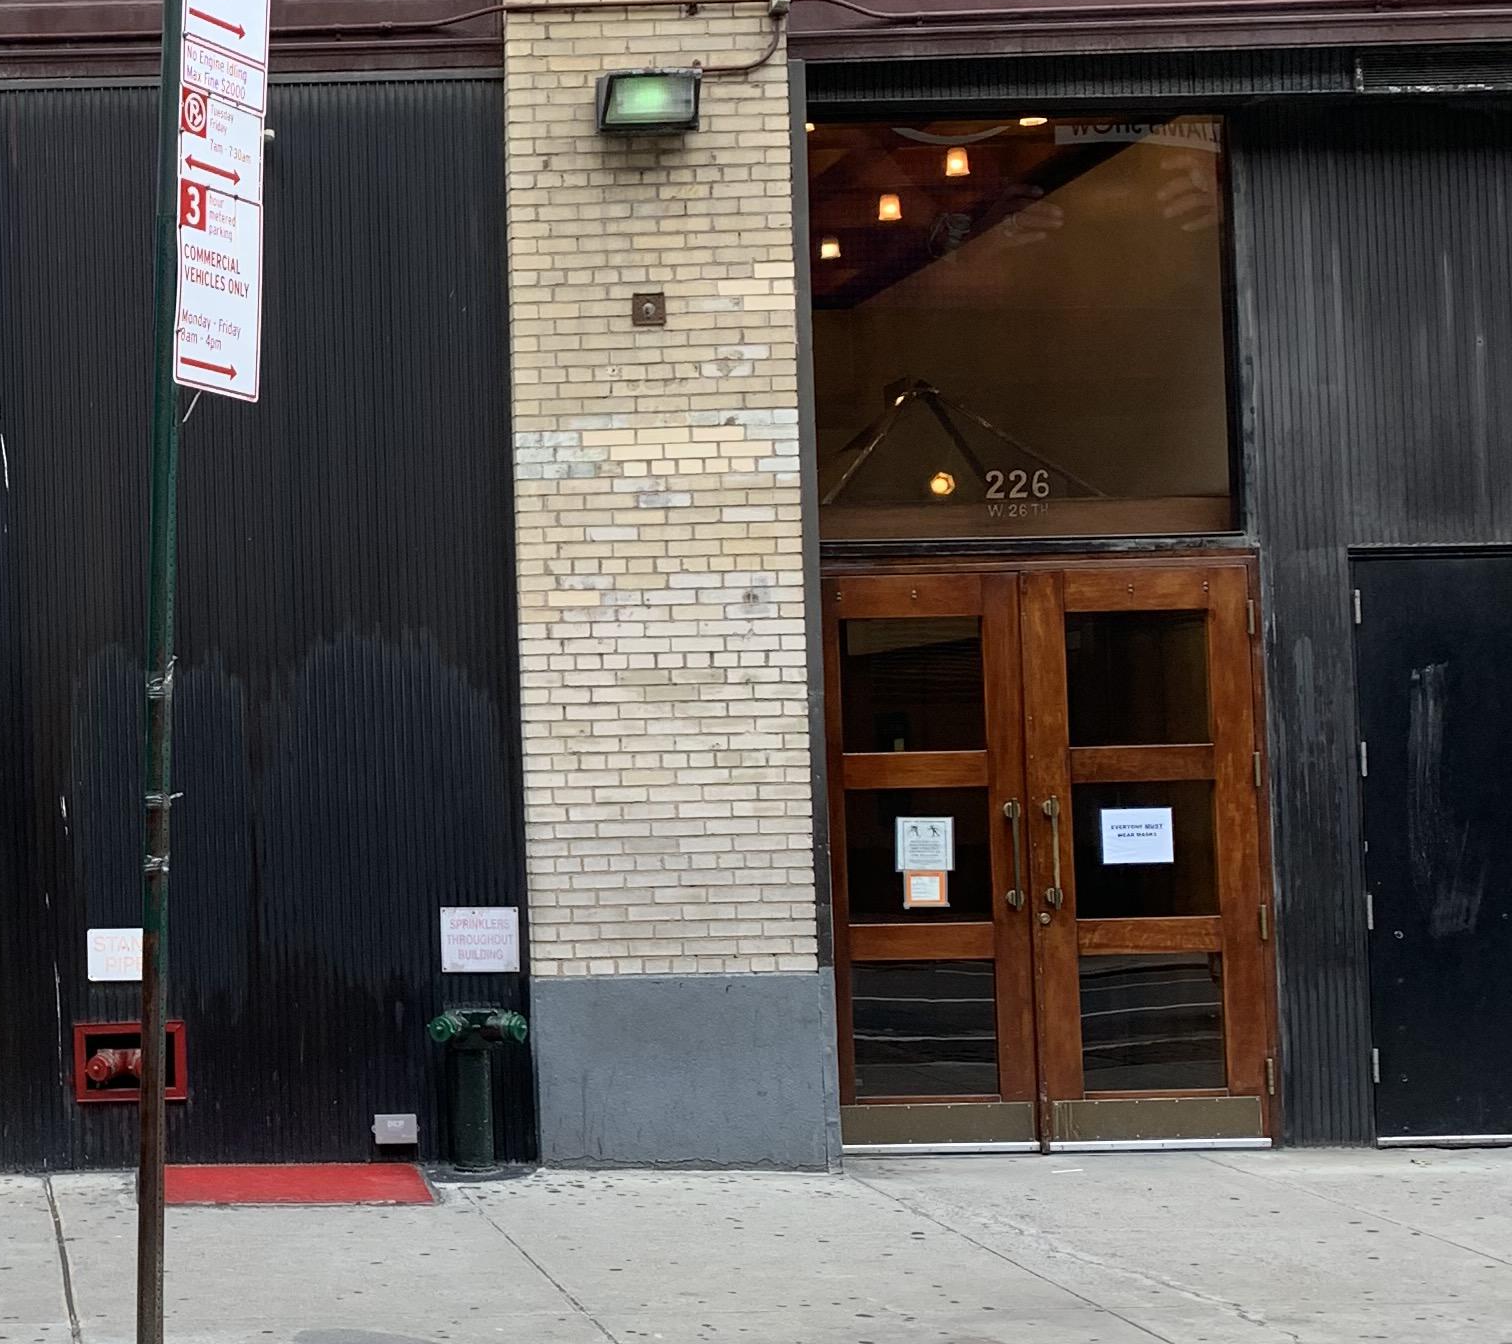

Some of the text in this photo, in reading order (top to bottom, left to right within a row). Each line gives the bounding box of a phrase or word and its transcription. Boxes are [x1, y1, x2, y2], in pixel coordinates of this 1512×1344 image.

[186, 45, 248, 85] No Engine Idling
[186, 64, 246, 100] Max Fine $2000
[210, 103, 234, 124] Tuesday
[209, 118, 227, 135] Friday
[229, 145, 252, 164] 730am
[185, 185, 201, 225] 3
[209, 193, 225, 209] hour
[209, 210, 237, 228] metered
[208, 224, 233, 243] parking
[184, 242, 241, 275] COMMERCIAL
[184, 264, 250, 299] VEHICLES ONLY
[181, 308, 211, 331] Monday
[218, 318, 242, 341] Friday
[180, 326, 198, 344] 8am
[205, 334, 222, 351] 4pm
[985, 468, 1050, 499] 226
[449, 917, 511, 930] SPRINKLERS
[93, 935, 143, 953] STAN
[447, 934, 514, 946] THROUGHOUT
[457, 948, 505, 961] BUILDING
